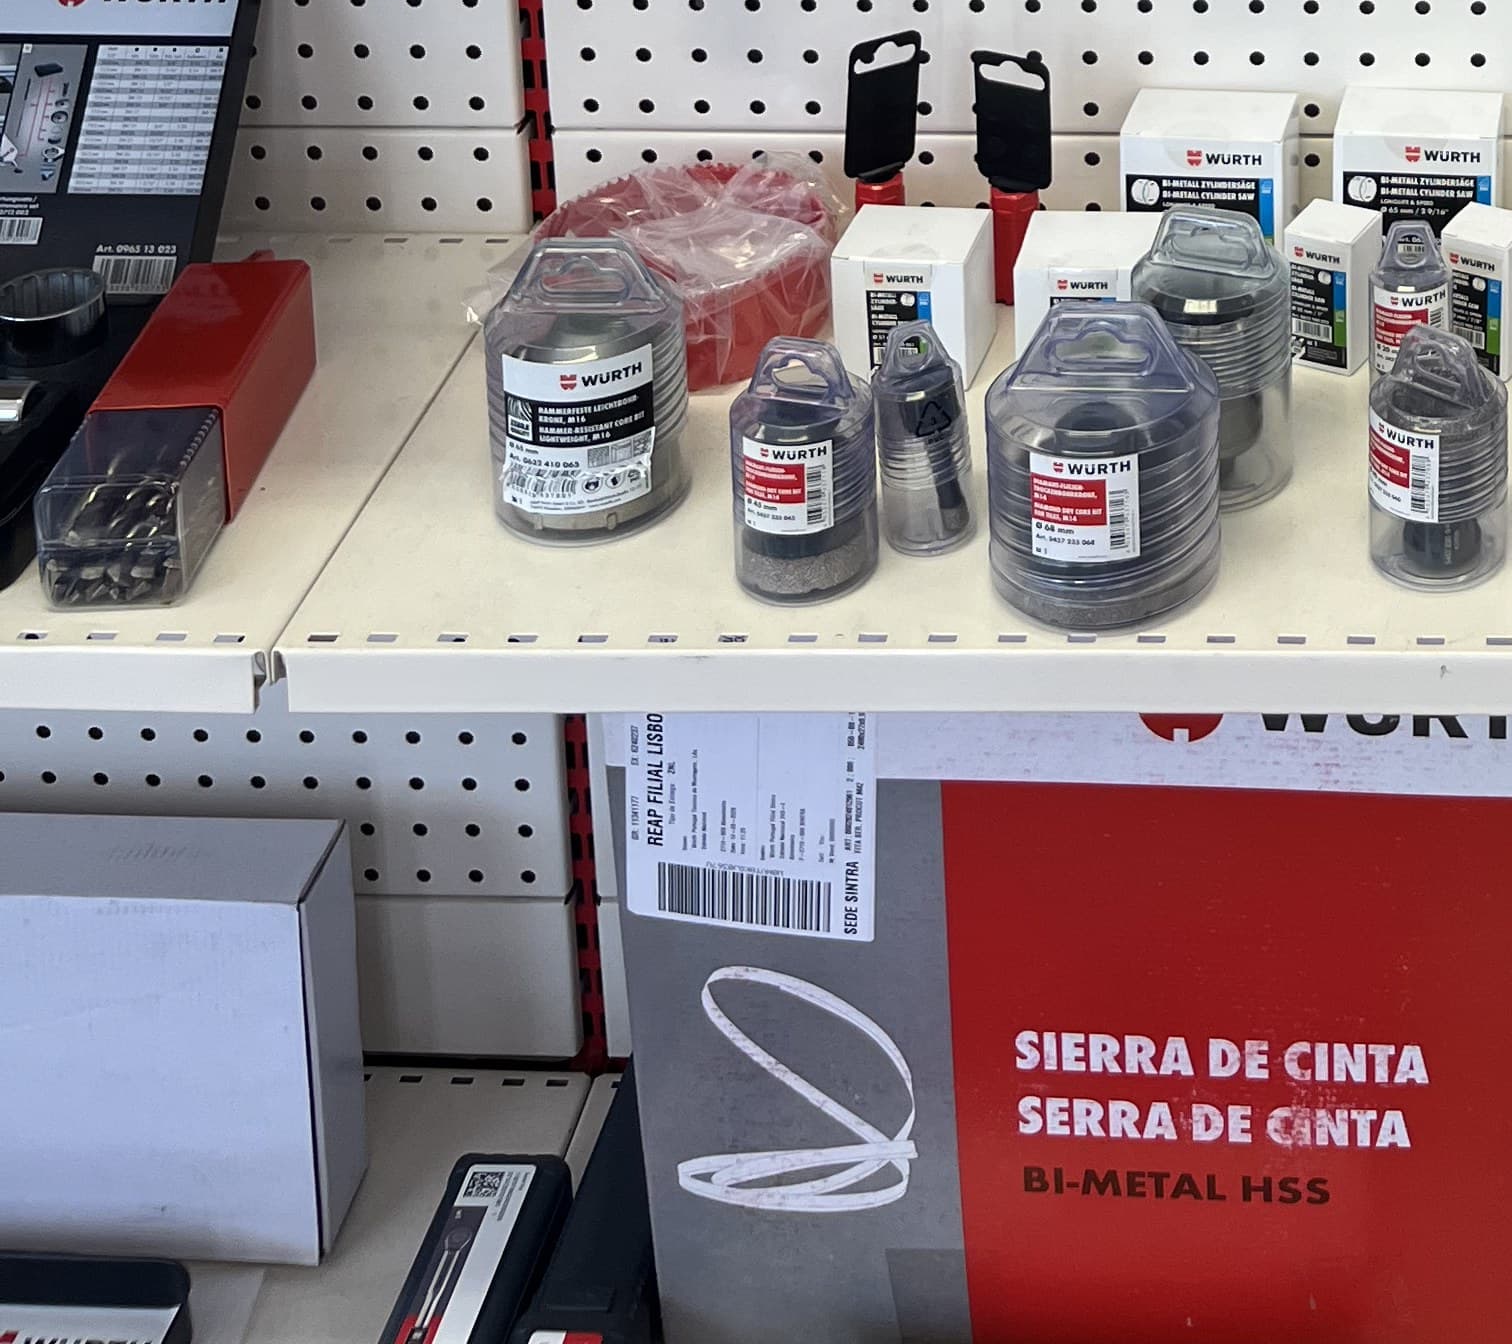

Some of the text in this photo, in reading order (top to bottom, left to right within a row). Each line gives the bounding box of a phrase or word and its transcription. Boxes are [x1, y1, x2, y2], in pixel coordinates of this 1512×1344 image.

[1206, 153, 1262, 166] WÜRTH
[1424, 150, 1480, 163] WÜRTH
[96, 244, 114, 254] Art.
[142, 245, 152, 254] 13
[155, 245, 177, 254] 023
[1306, 252, 1340, 264] WÜRTH
[1460, 257, 1494, 272] WÜRTH
[1070, 280, 1109, 291] WÜRTH
[1402, 289, 1446, 307] WÜRTH
[582, 362, 642, 387] WÜRTH
[1387, 428, 1434, 449] WÜRTH
[773, 446, 826, 460] WÜRTH
[1068, 460, 1130, 474] WÜRTH
[647, 713, 663, 847] REAP FILIAL LISBO
[845, 861, 859, 903] SINTRA
[844, 906, 858, 935] SEDE
[1015, 1029, 1429, 1085] SIERRA DE CINTA
[1017, 1095, 1411, 1148] SERRA DE CINTA
[1022, 1165, 1331, 1205] BI-METAL HSS
